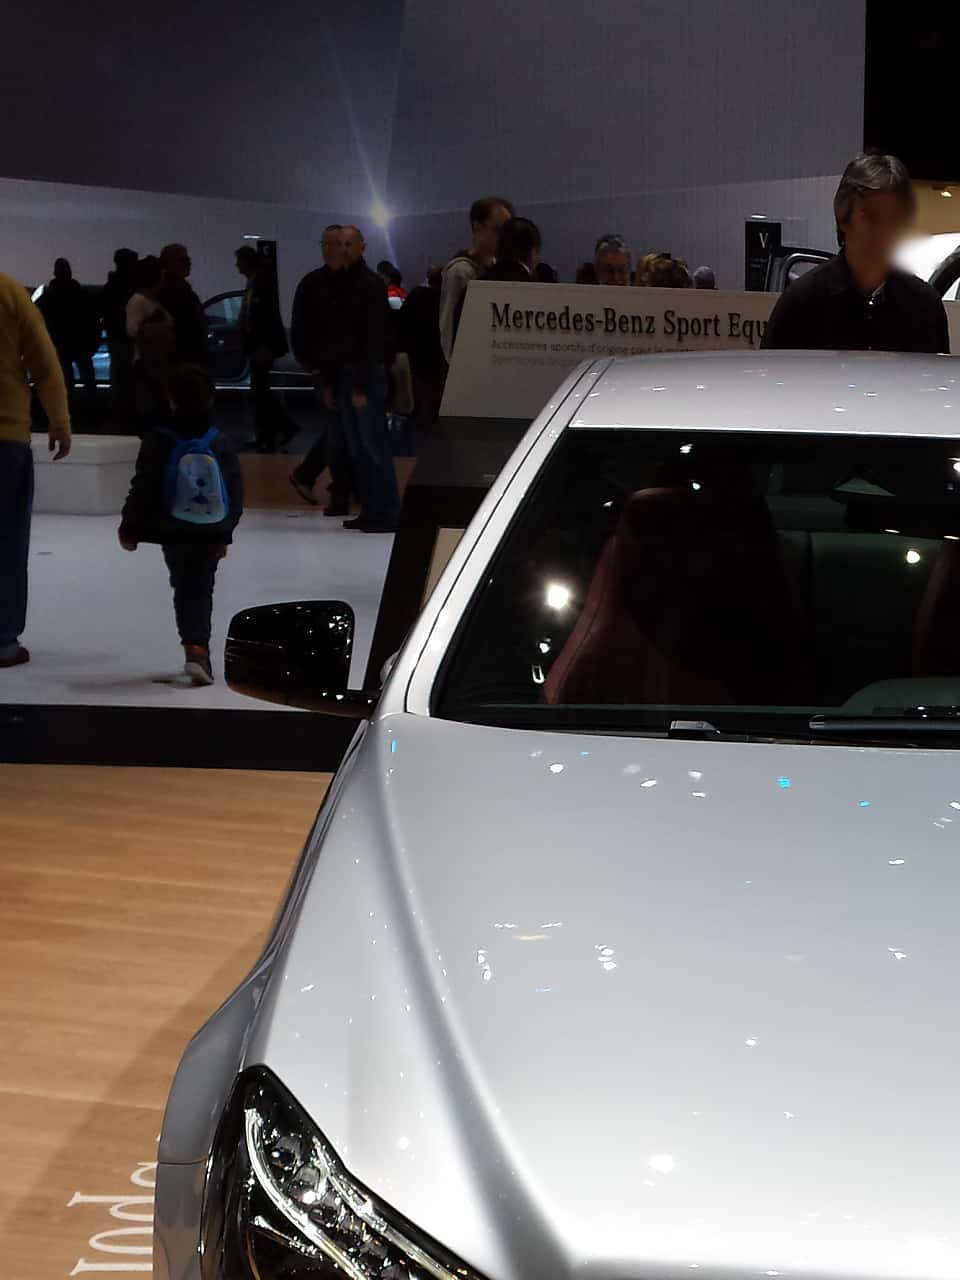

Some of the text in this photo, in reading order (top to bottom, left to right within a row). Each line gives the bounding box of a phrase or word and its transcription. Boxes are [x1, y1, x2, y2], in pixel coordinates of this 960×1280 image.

[759, 232, 769, 249] V
[490, 302, 656, 335] Mercedes-Benz
[663, 309, 721, 343] Sport
